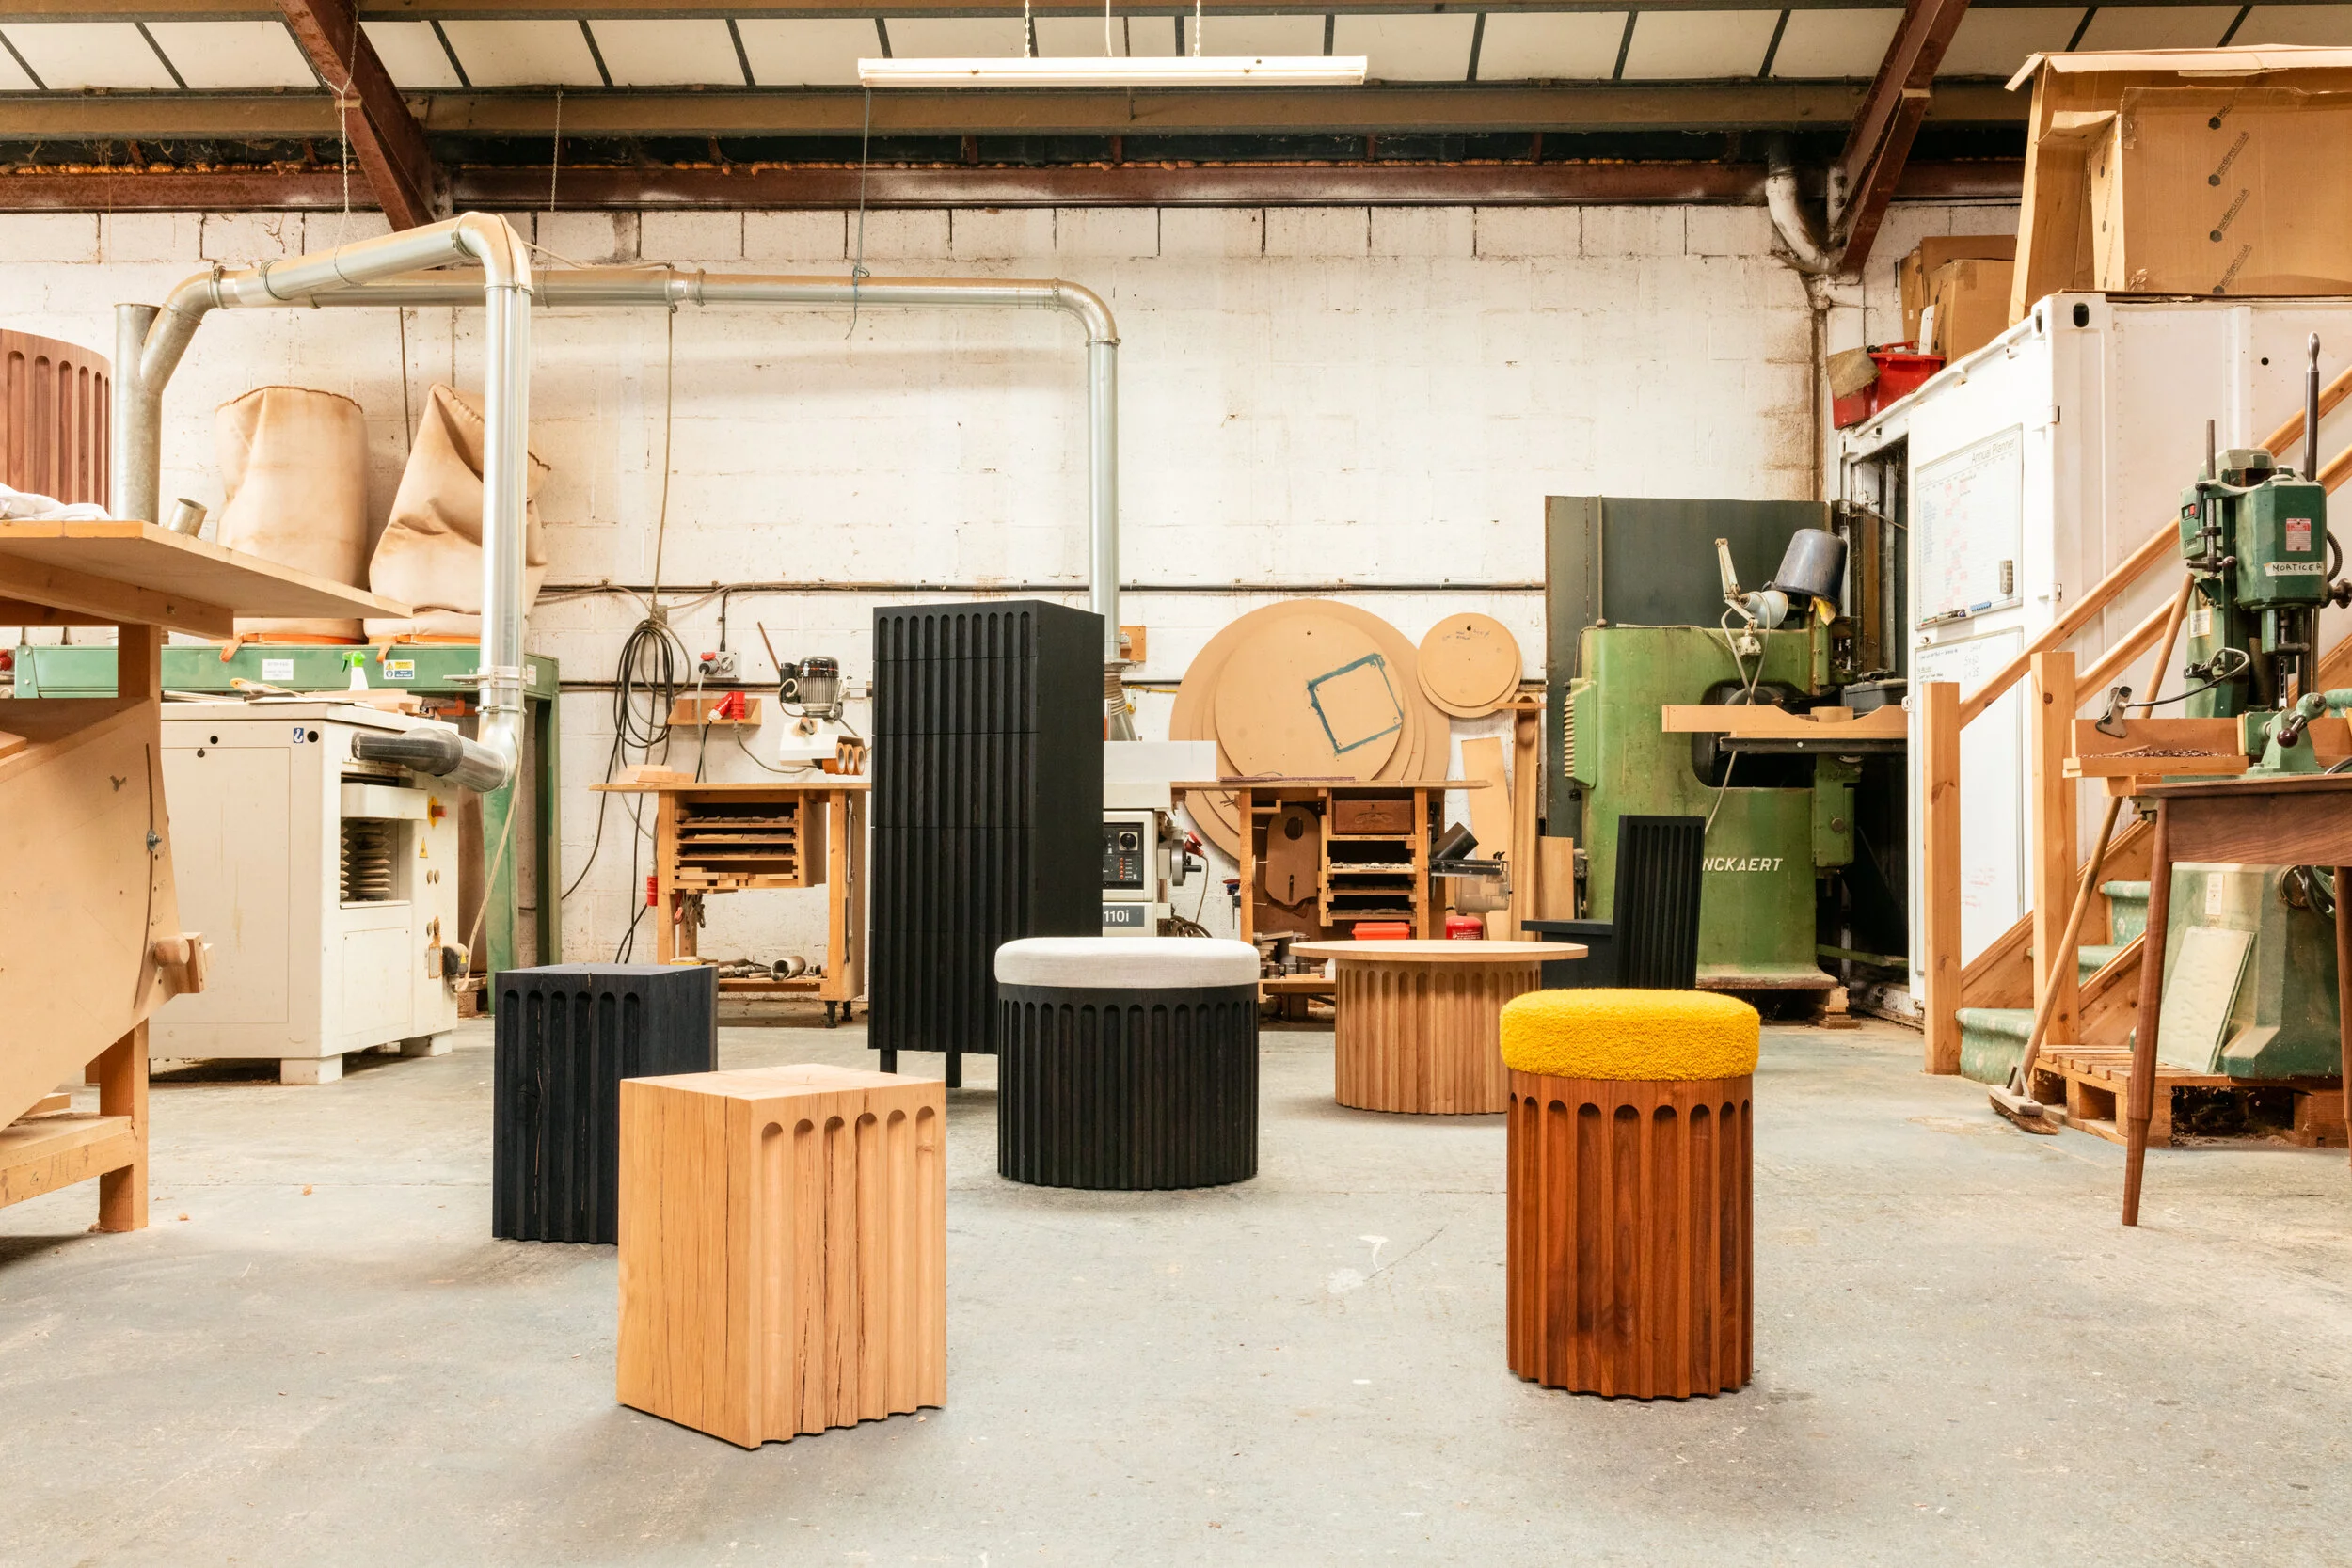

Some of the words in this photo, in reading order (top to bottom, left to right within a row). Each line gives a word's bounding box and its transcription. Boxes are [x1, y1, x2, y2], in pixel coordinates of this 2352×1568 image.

[2217, 131, 2249, 174] ascdirect.co.uk
[2217, 188, 2249, 231] ascdirect.co.uk
[2220, 245, 2250, 286] ascdirect.co.uk
[1972, 448, 1991, 464] Annual
[1993, 438, 2015, 456] Planner
[1702, 857, 1784, 872] NCKAERT
[1104, 910, 1129, 922] 110i
